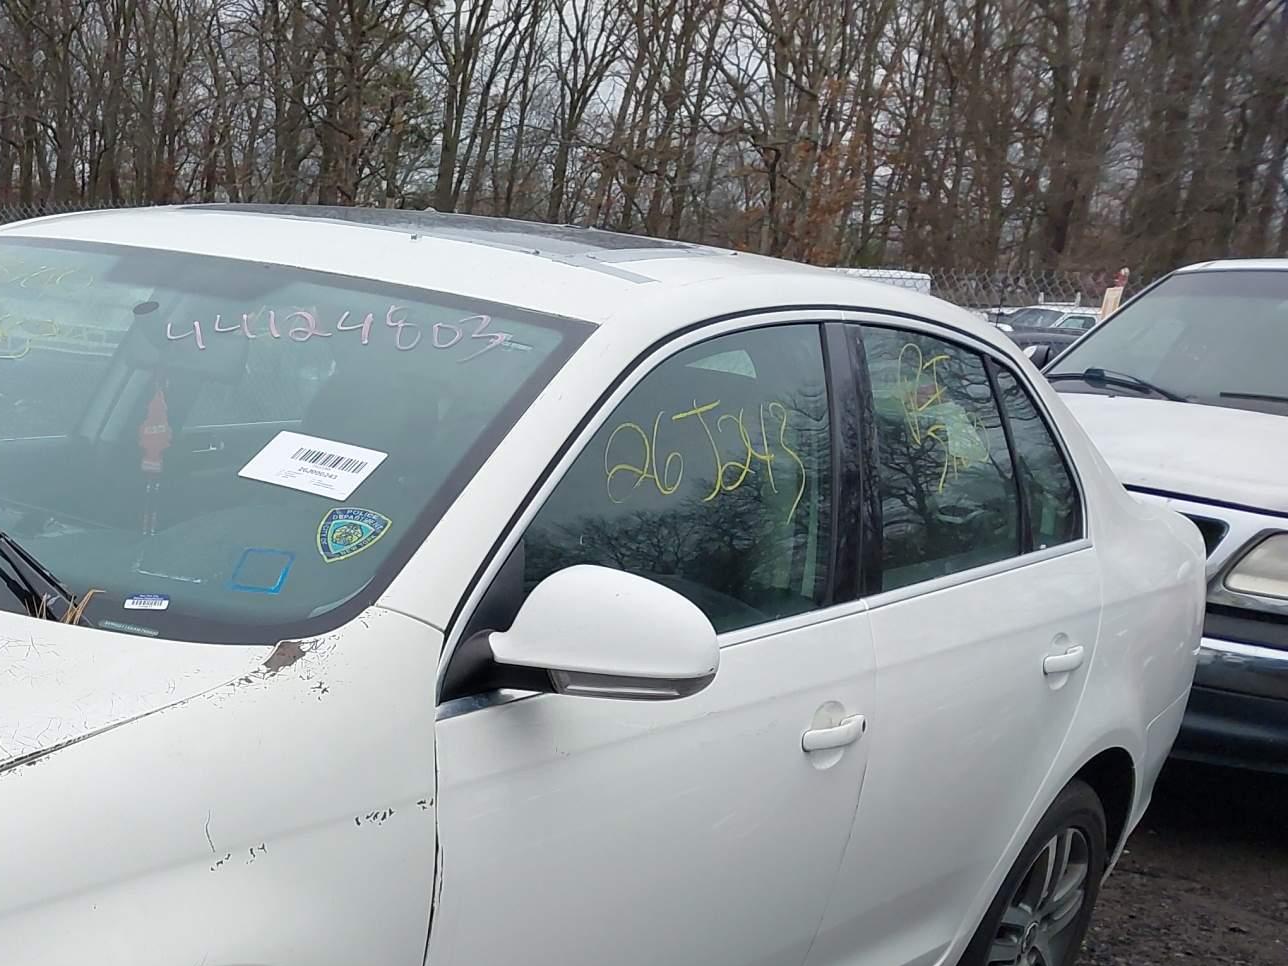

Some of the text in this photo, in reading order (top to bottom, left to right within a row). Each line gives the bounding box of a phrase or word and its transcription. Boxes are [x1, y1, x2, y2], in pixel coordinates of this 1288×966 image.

[166, 304, 505, 364] 44124803
[332, 514, 384, 531] DEPARTMENT
[346, 509, 380, 520] POLICE
